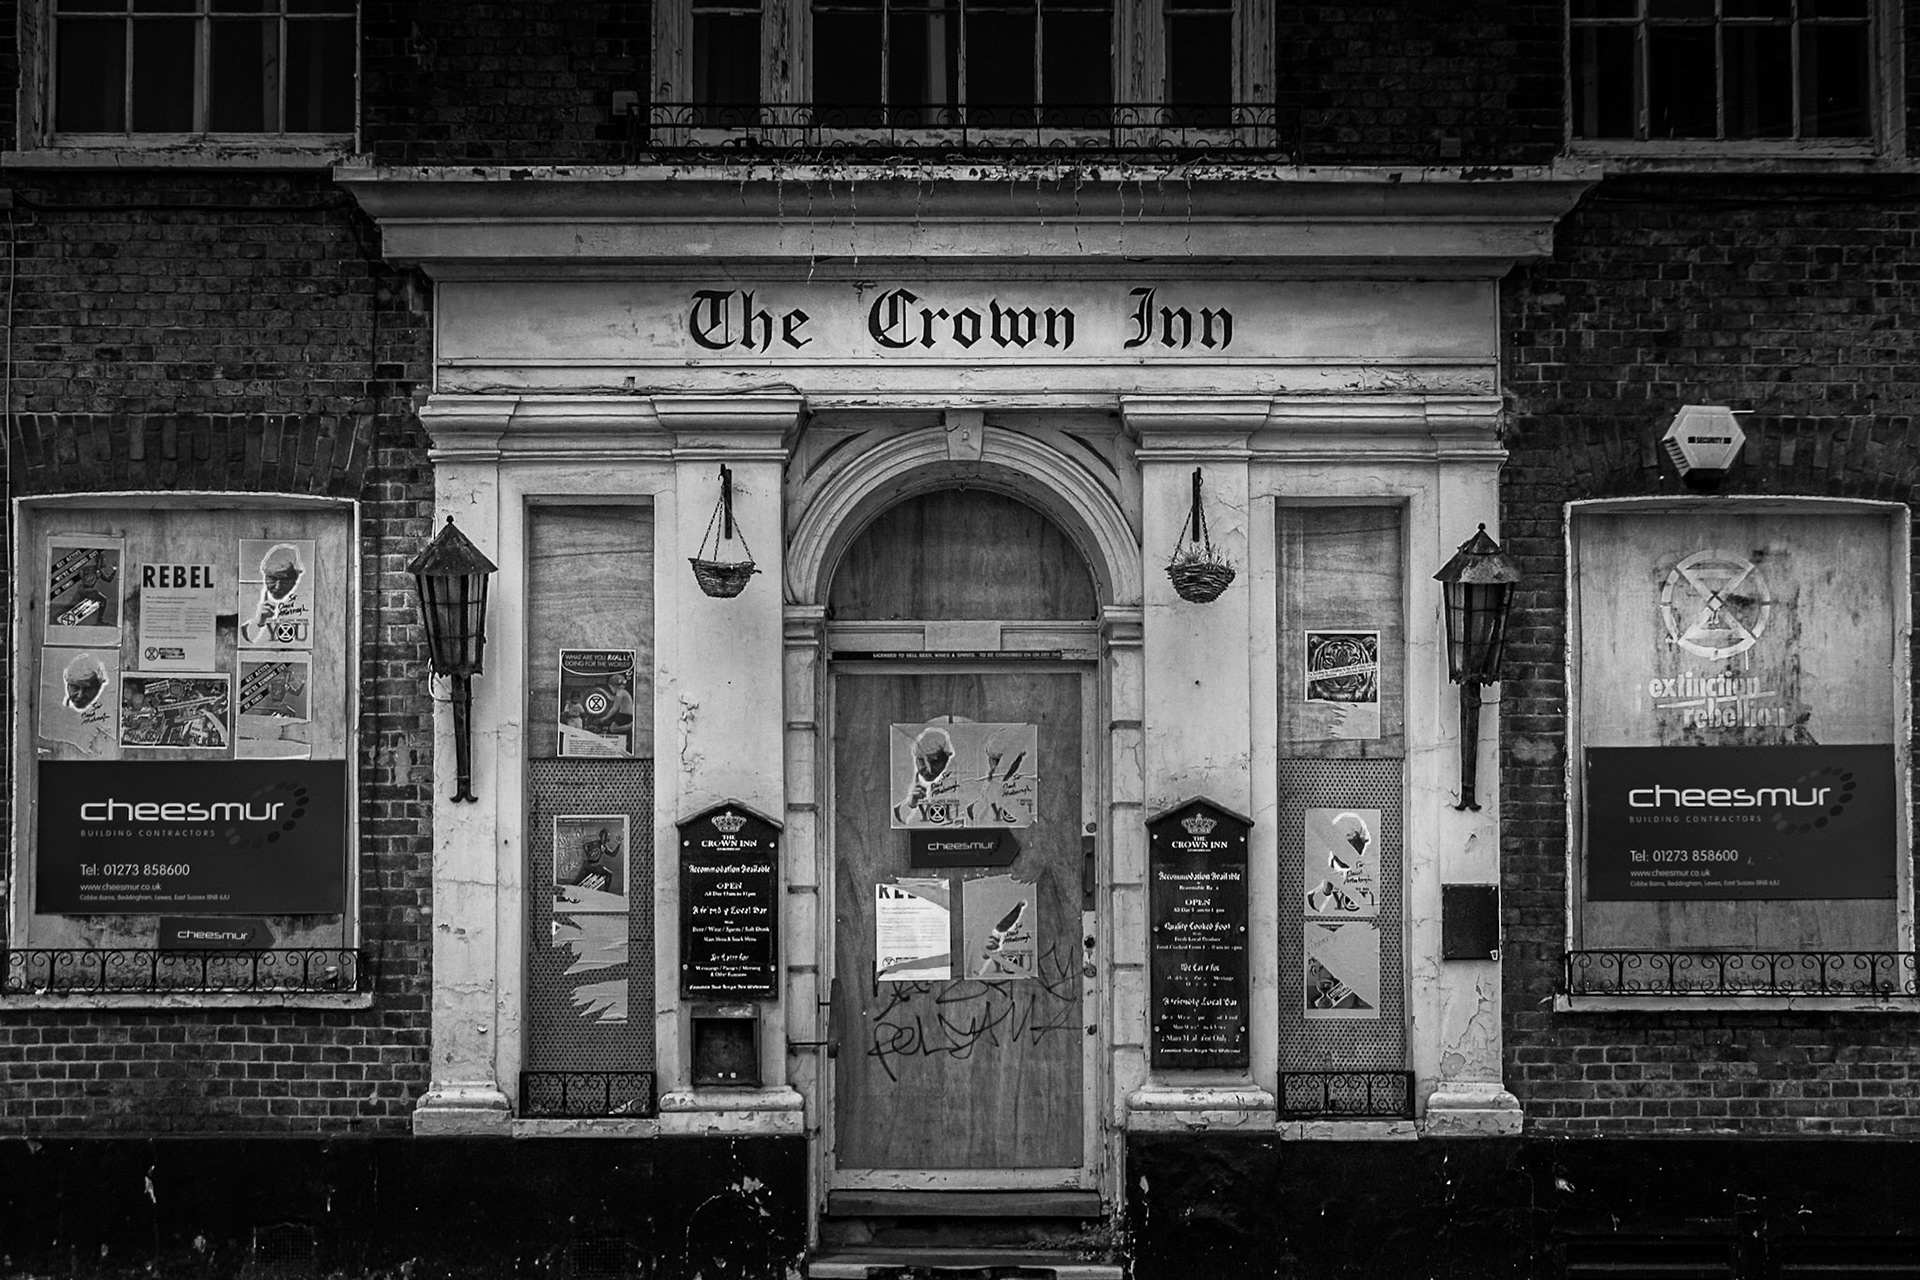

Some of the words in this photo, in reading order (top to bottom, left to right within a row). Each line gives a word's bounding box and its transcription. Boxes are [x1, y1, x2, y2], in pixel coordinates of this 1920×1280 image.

[689, 288, 813, 355] The
[868, 288, 1076, 352] Crown
[1123, 286, 1233, 352] Inn
[143, 565, 214, 588] REBEL
[1629, 785, 1830, 807] cheesmur
[81, 798, 284, 821] cheesmur
[928, 842, 994, 851] cheesmur
[1630, 850, 1649, 862] Tel:
[1653, 850, 1688, 862] 01273
[1692, 850, 1739, 862] 858600
[80, 864, 100, 876] Tel:
[104, 864, 139, 876] 01273
[143, 864, 190, 876] 858600
[177, 930, 248, 940] cheesmur
